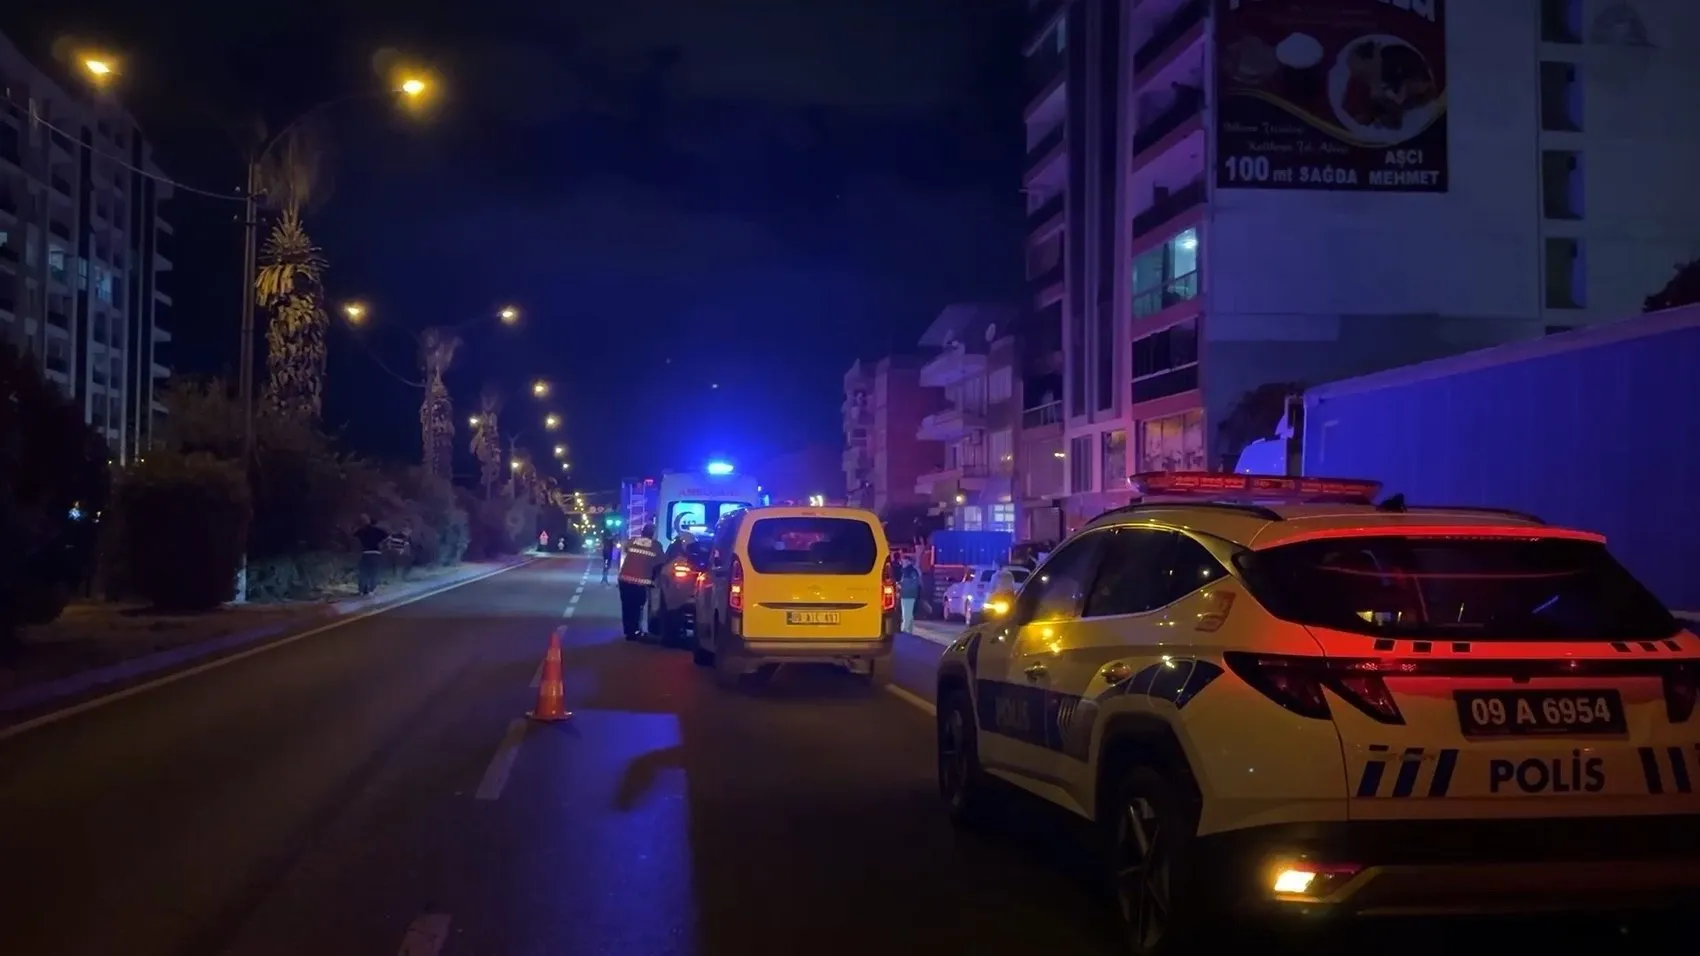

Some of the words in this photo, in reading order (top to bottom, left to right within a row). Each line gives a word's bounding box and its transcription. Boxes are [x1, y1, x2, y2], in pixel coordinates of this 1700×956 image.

[1225, 156, 1269, 182] 100
[1273, 168, 1292, 182] mt
[1300, 165, 1357, 184] SAĞDA
[1385, 150, 1423, 168] AŞCI
[1369, 170, 1439, 185] MEHMET
[1471, 698, 1506, 725] 09
[1516, 698, 1537, 724] A
[1542, 698, 1612, 723] 6954
[1490, 749, 1606, 793] POLİS
